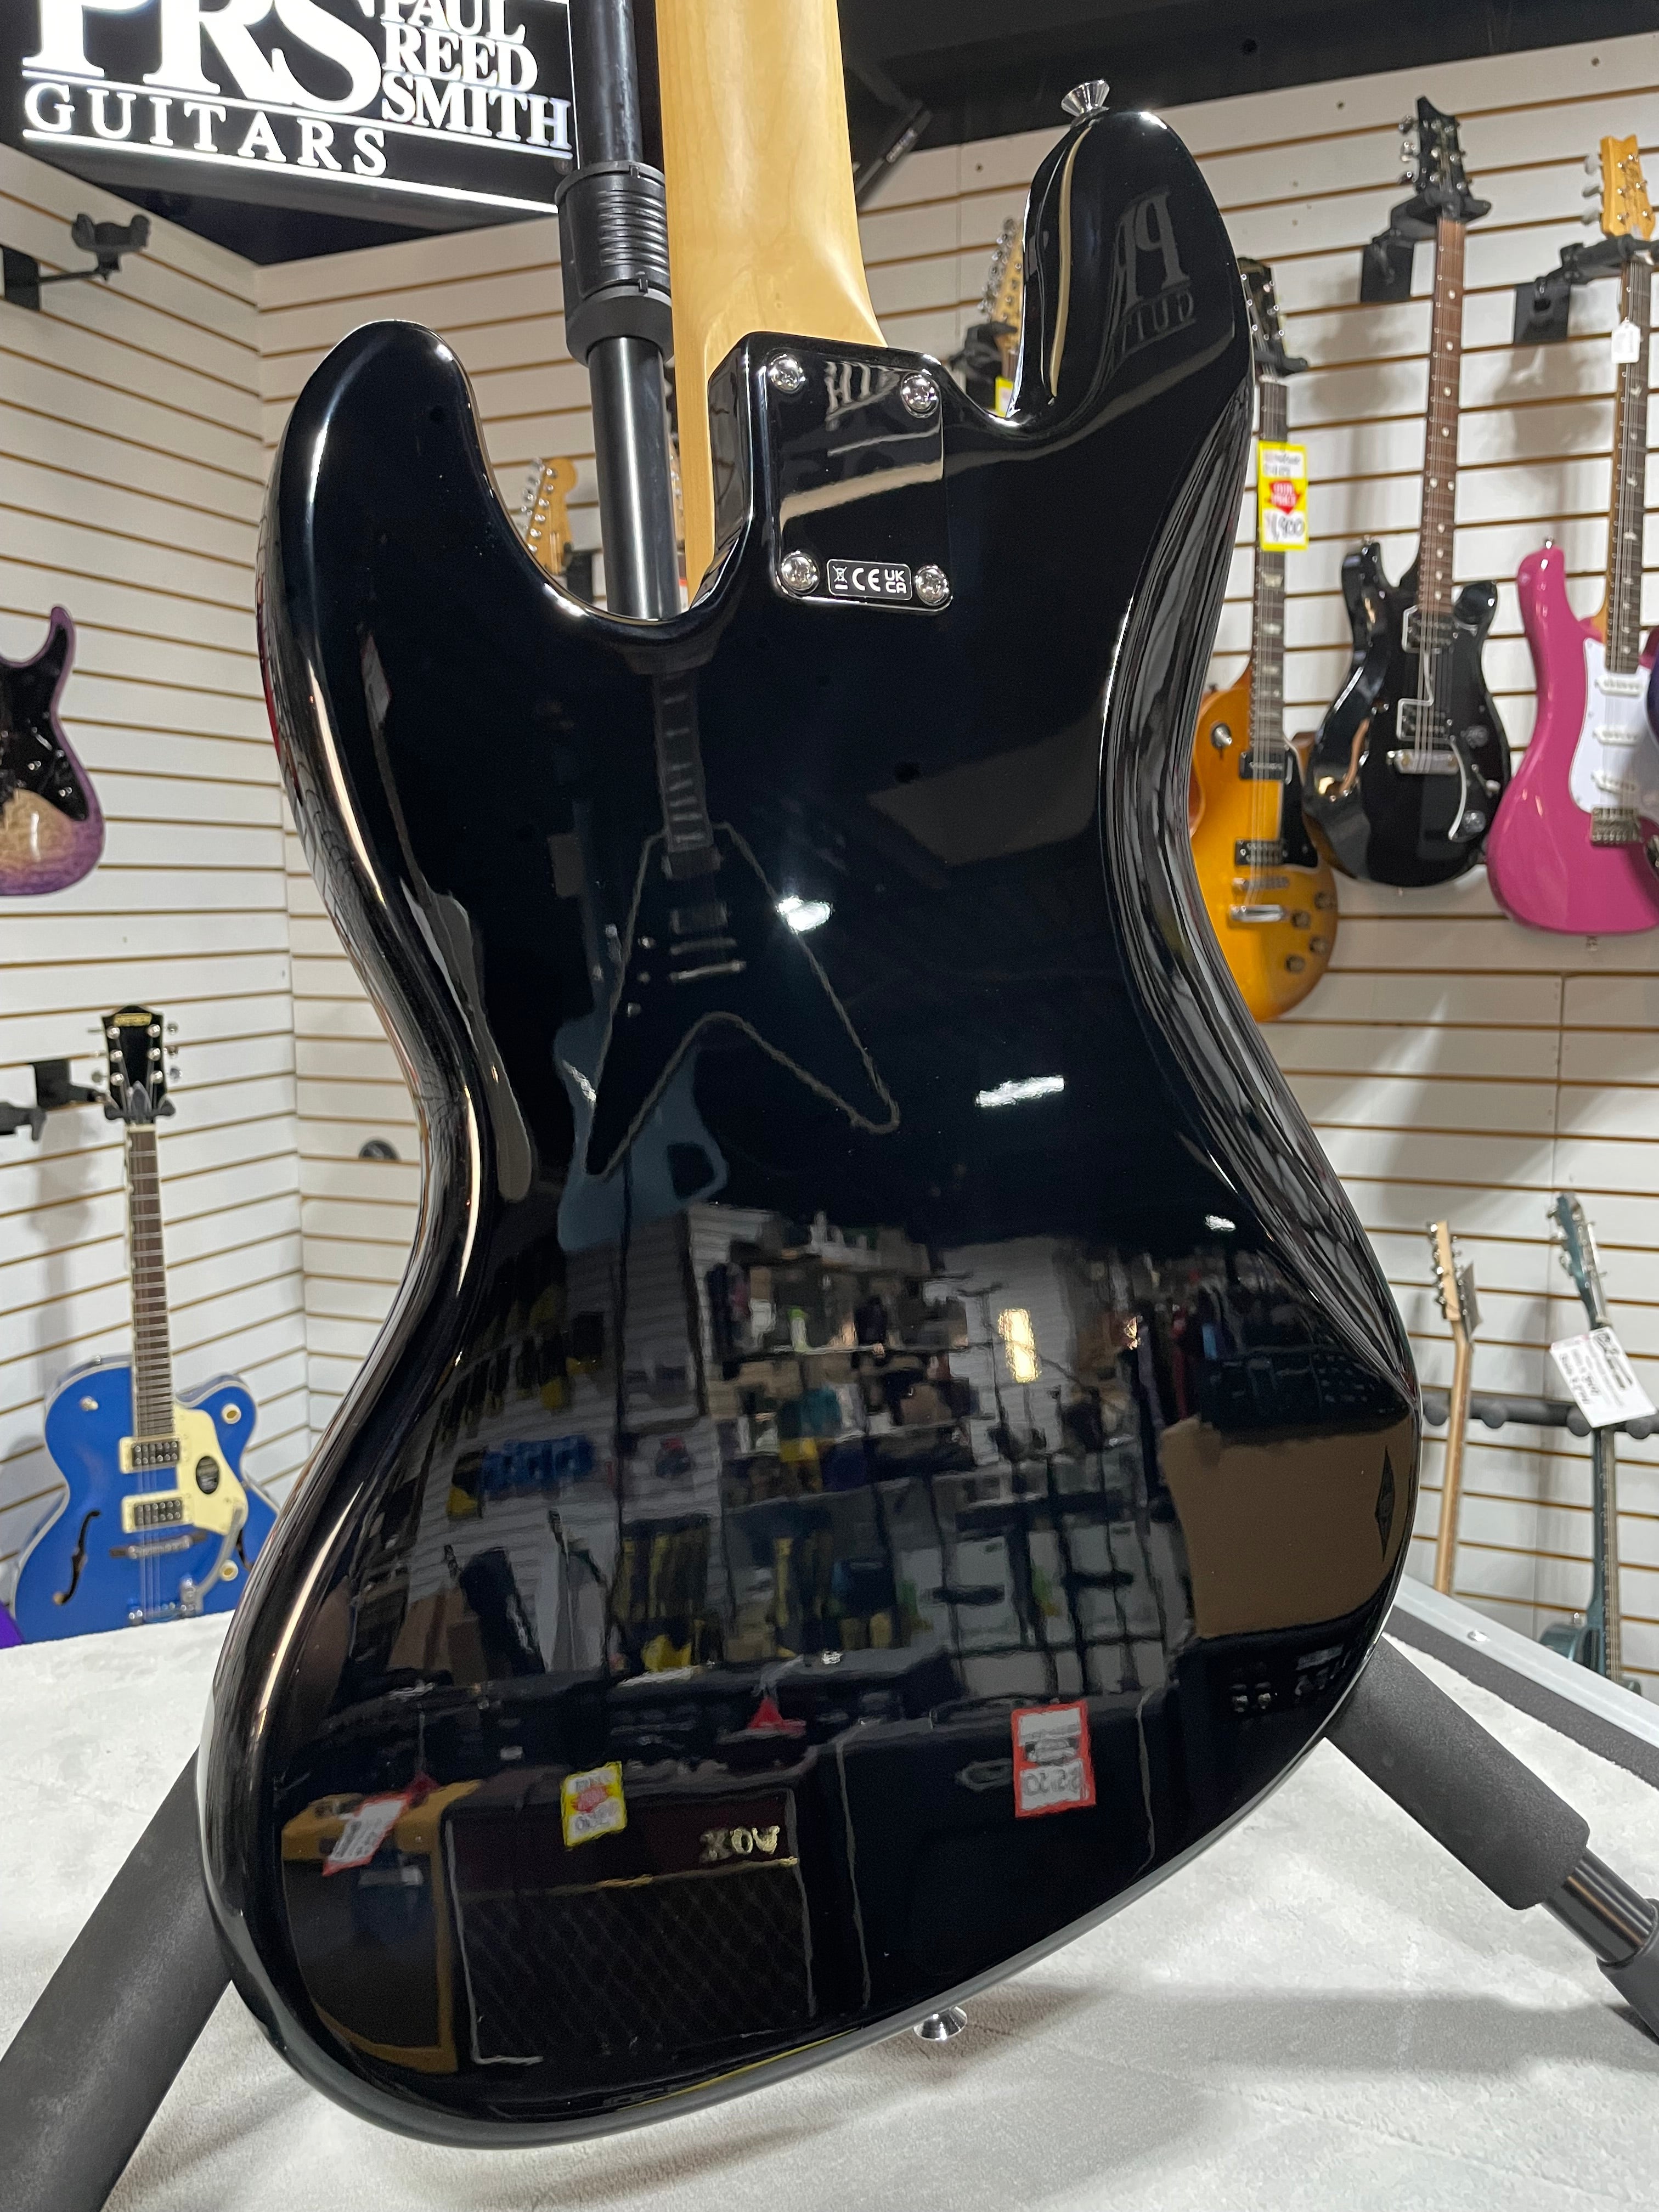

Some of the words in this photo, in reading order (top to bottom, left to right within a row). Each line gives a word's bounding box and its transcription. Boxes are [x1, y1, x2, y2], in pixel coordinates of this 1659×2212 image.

[381, 22, 538, 93] REED
[24, 82, 386, 177] GUITARS
[382, 72, 572, 150] SMITH
[852, 567, 881, 592] CE
[884, 569, 905, 582] UK
[885, 582, 907, 594] CA
